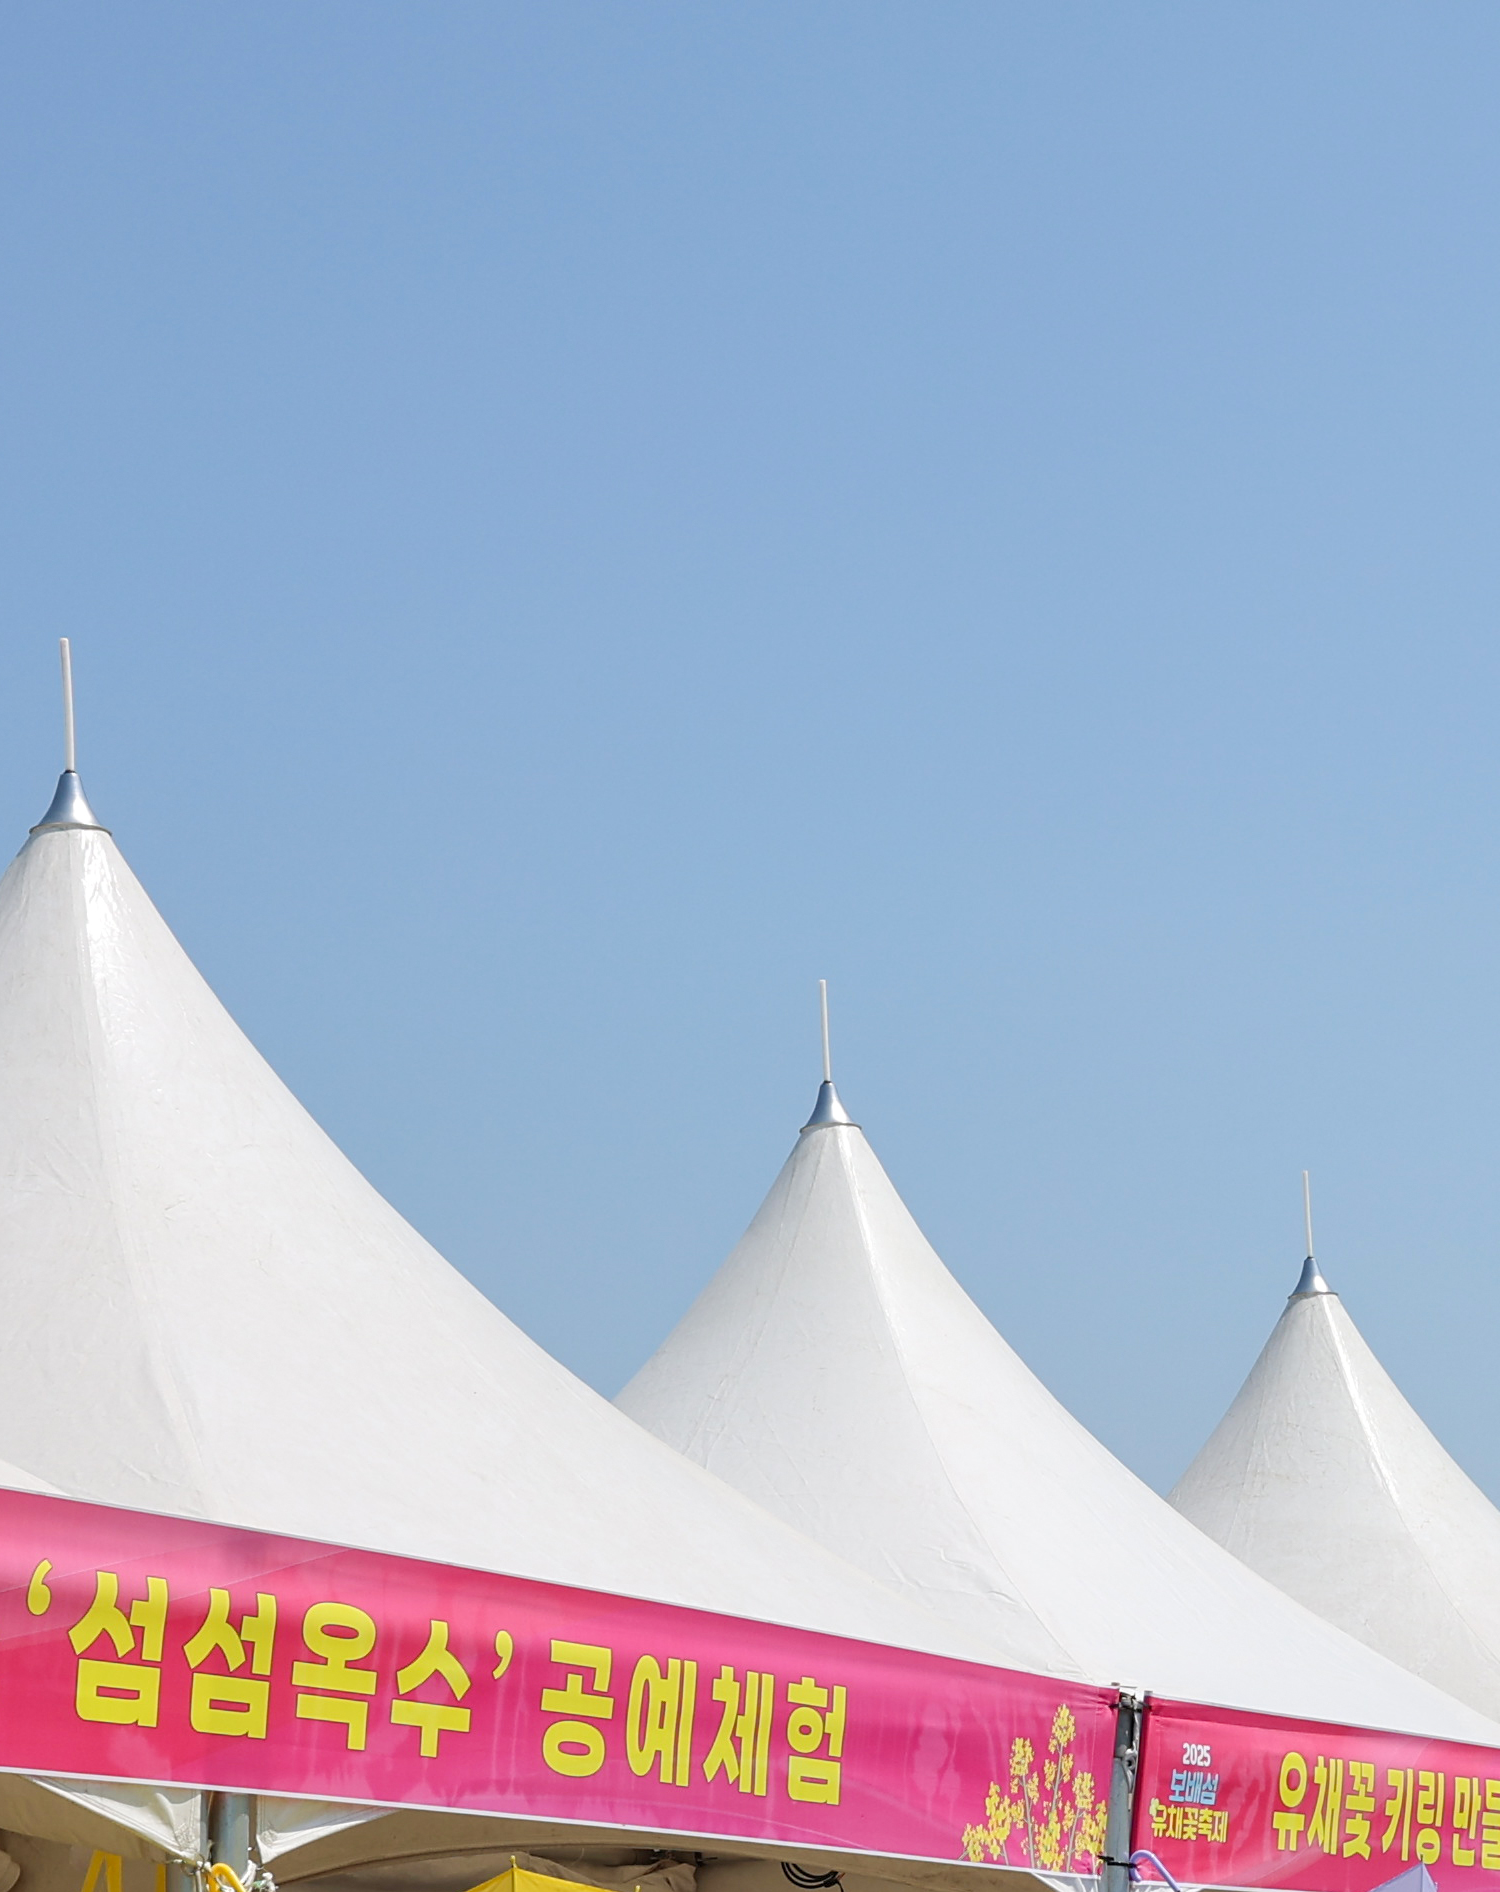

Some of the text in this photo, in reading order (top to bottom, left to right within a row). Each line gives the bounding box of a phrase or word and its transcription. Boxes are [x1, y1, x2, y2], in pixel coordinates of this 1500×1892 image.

[539, 1638, 849, 1807] 공예체험
[1182, 1742, 1212, 1768] 2025
[1168, 1768, 1220, 1806] 보배섬
[1150, 1804, 1230, 1844] 유채꽃축제
[1272, 1751, 1377, 1861] 유채꽃
[1381, 1766, 1446, 1865] 키링
